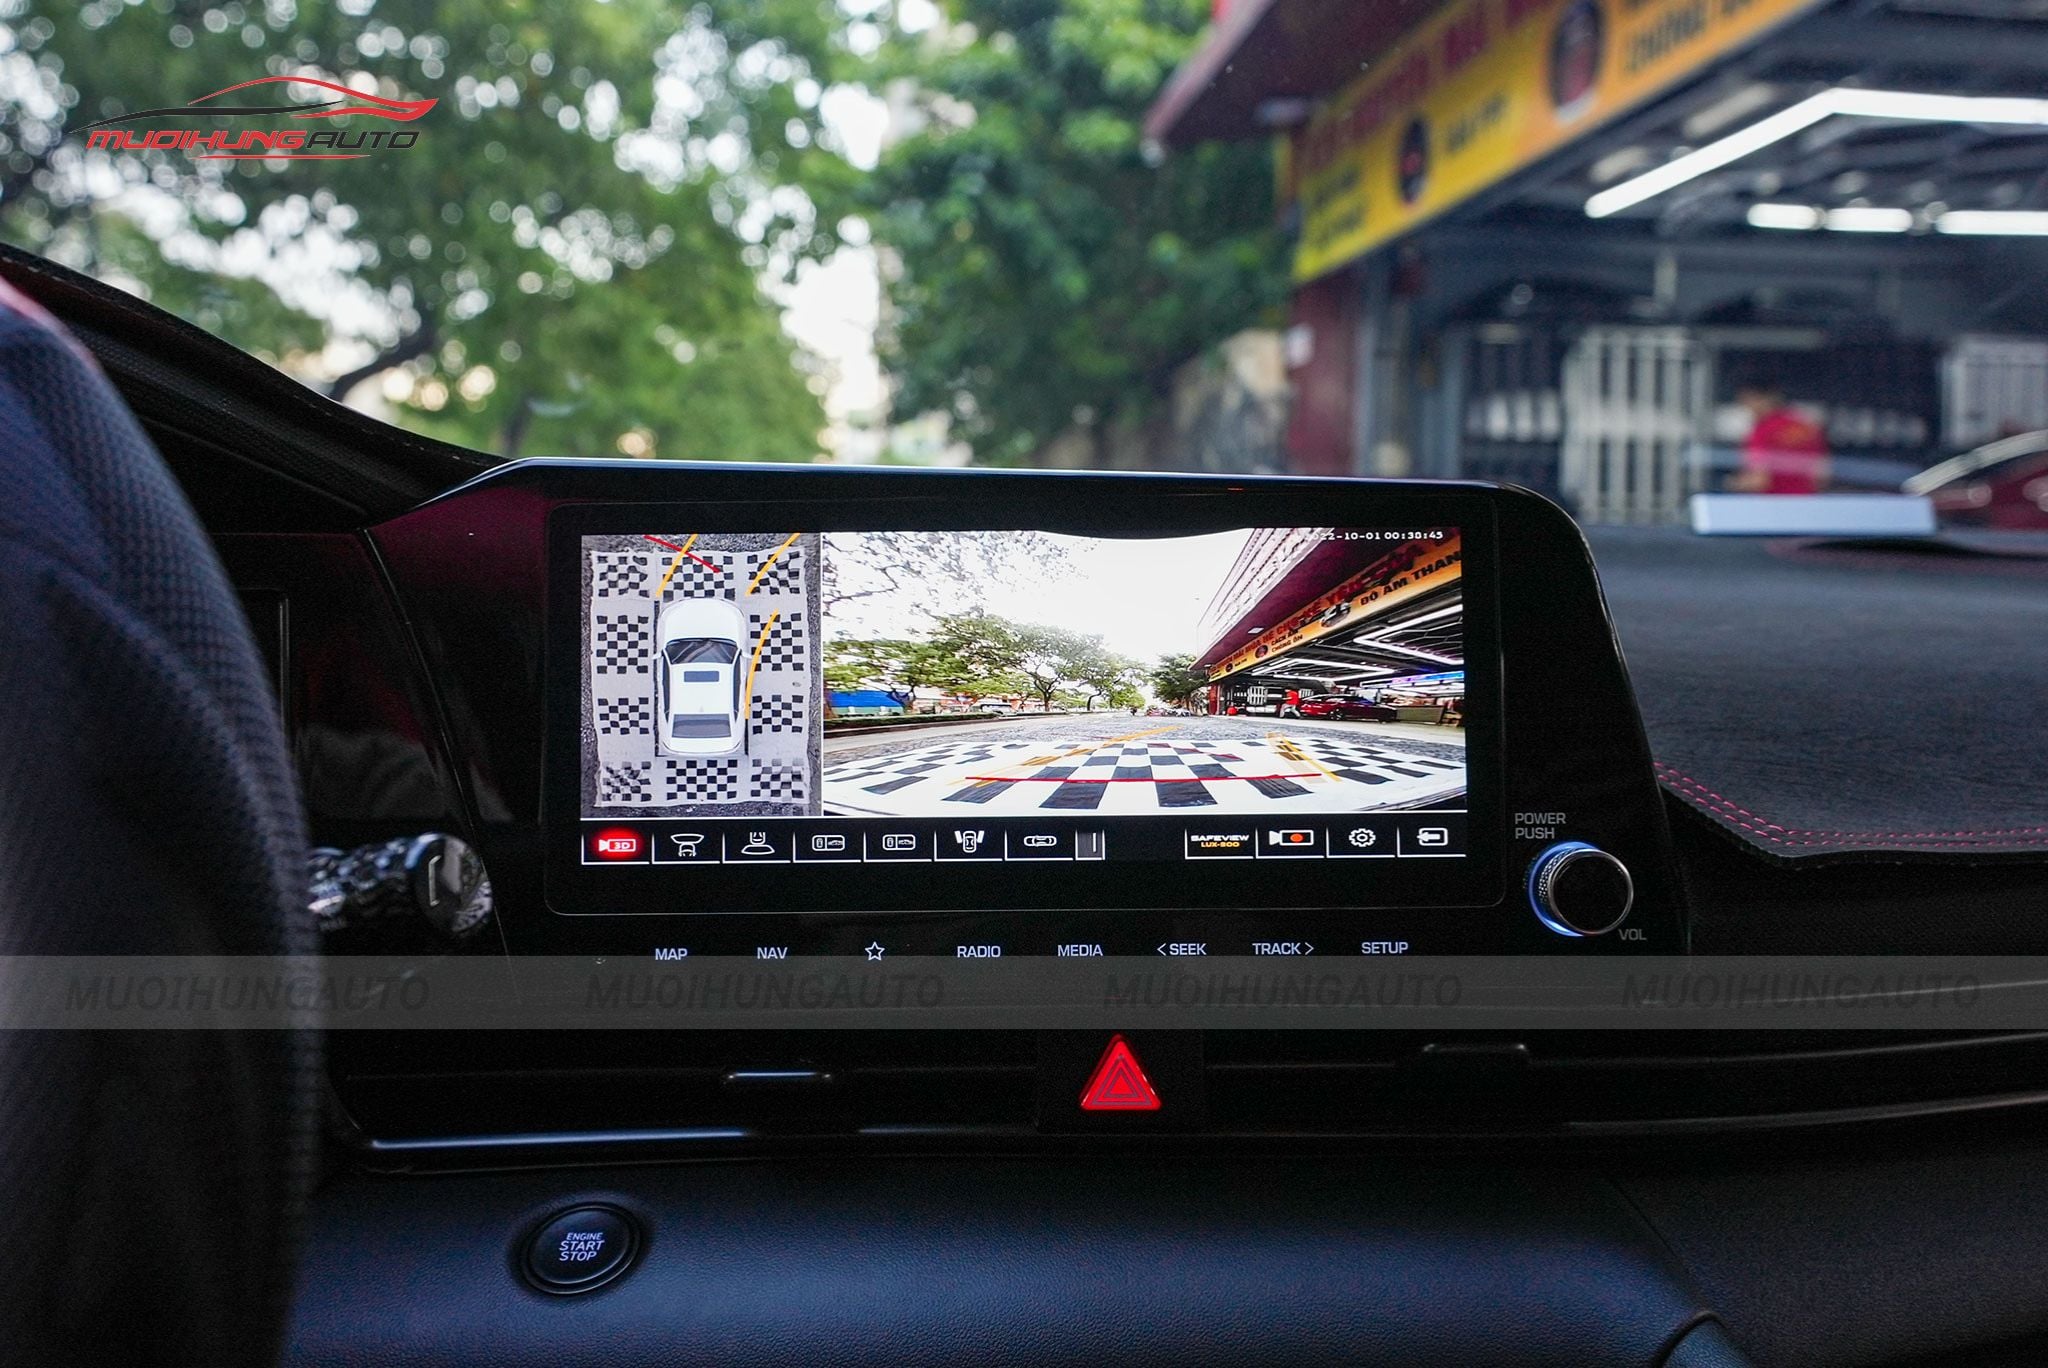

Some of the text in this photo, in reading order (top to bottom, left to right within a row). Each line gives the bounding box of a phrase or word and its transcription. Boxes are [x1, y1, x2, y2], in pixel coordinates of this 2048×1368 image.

[1515, 812, 1566, 825] POWER
[1515, 827, 1555, 839] PUSH
[613, 841, 631, 850] 3D
[1618, 928, 1647, 941] VOL
[757, 946, 788, 960] NAV
[957, 945, 1001, 958] RADIO
[1057, 944, 1104, 957] MEDIA
[1361, 941, 1409, 954] SETUP
[655, 948, 688, 961] MAP
[566, 1232, 603, 1241] ENGINE
[559, 1240, 605, 1251] START
[559, 1250, 597, 1261] STOP
